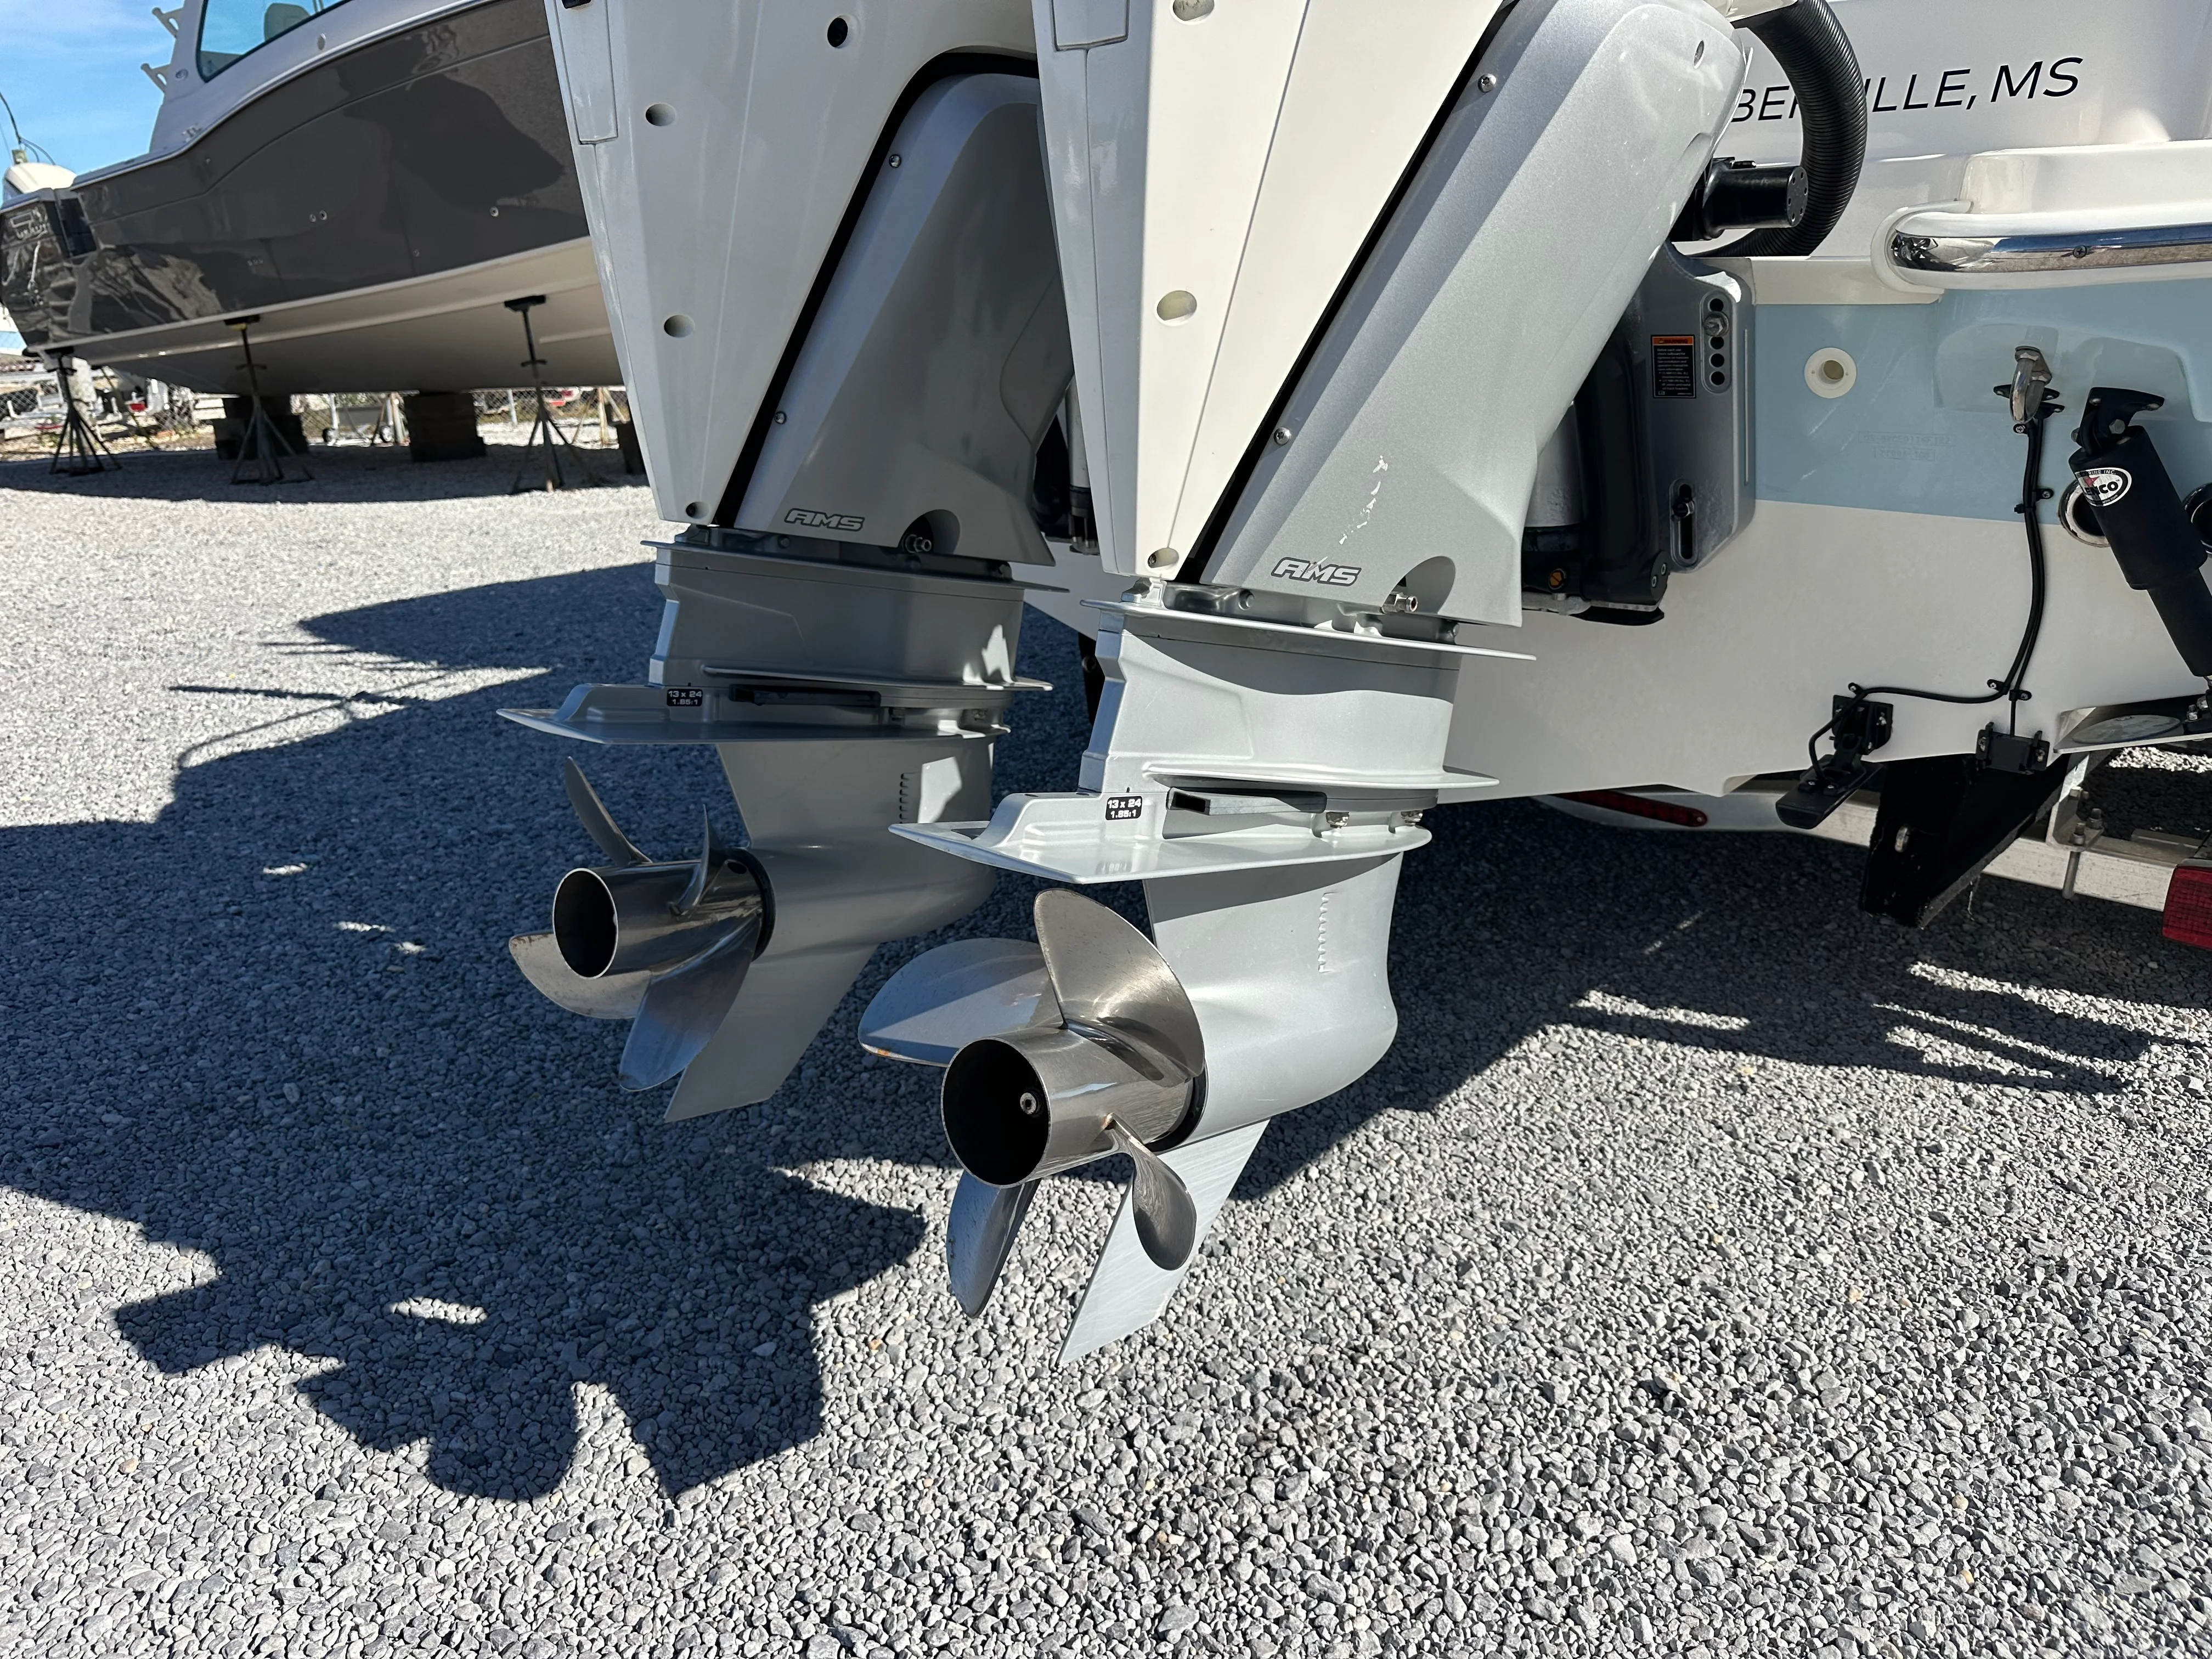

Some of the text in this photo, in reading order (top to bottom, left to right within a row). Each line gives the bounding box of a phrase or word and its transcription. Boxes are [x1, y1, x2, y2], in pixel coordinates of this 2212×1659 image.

[1990, 57, 2083, 103] MS
[785, 508, 865, 532] AMS
[1271, 557, 1362, 586] AMS
[1108, 799, 1119, 809] 13
[1128, 799, 1142, 808] 24
[1110, 809, 1137, 819] 1.85:1
